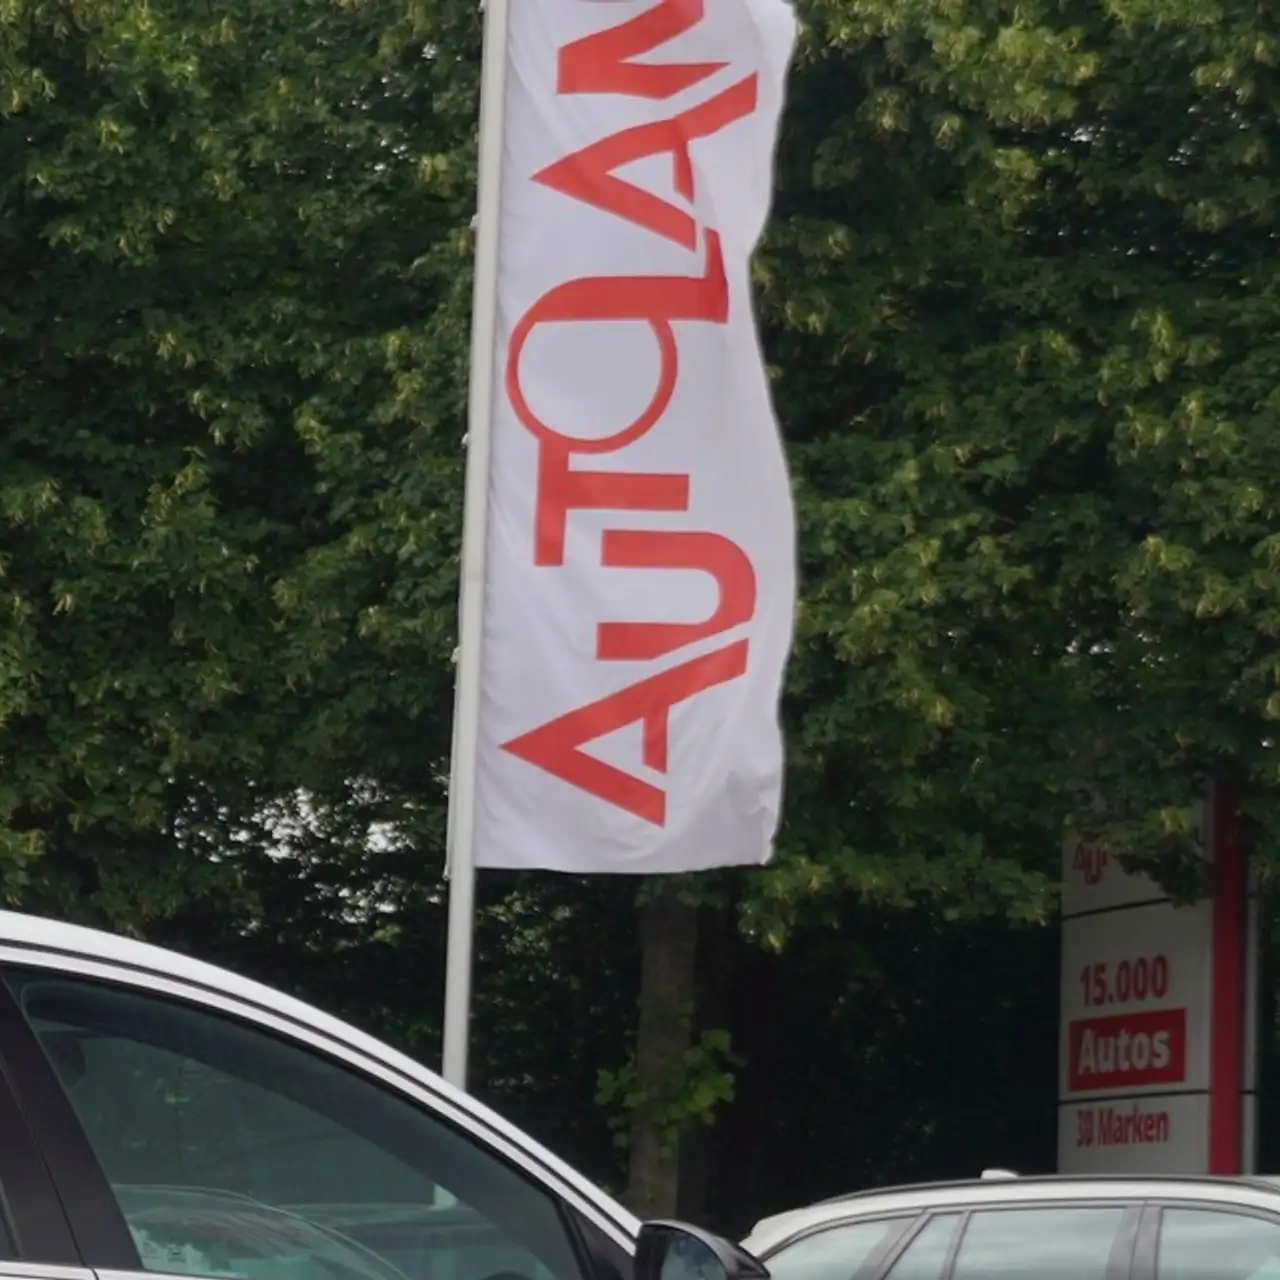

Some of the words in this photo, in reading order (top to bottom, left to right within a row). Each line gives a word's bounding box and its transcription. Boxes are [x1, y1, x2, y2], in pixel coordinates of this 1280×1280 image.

[1079, 955, 1169, 1007] 15.000
[1078, 1028, 1172, 1077] Autos
[1075, 1108, 1093, 1148] 30
[1097, 1105, 1169, 1146] Marken
